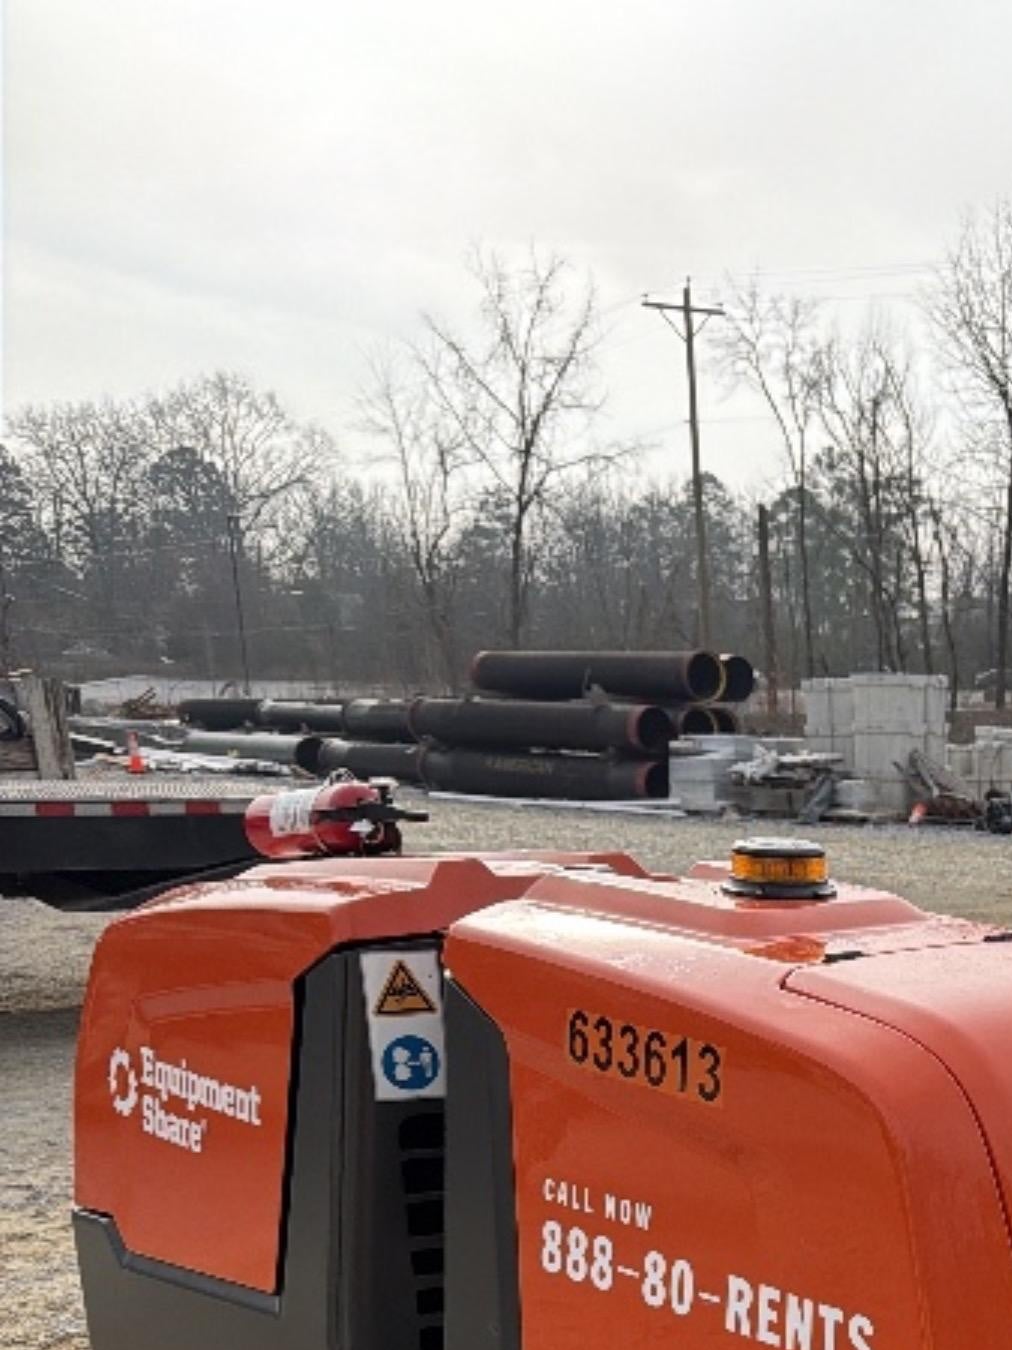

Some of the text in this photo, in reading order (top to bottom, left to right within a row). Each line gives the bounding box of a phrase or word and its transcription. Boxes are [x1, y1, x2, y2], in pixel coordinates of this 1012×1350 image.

[139, 1045, 263, 1126] Equipment
[568, 1009, 721, 1102] 633613
[142, 1094, 203, 1153] Share
[543, 1177, 653, 1231] CALL NOW
